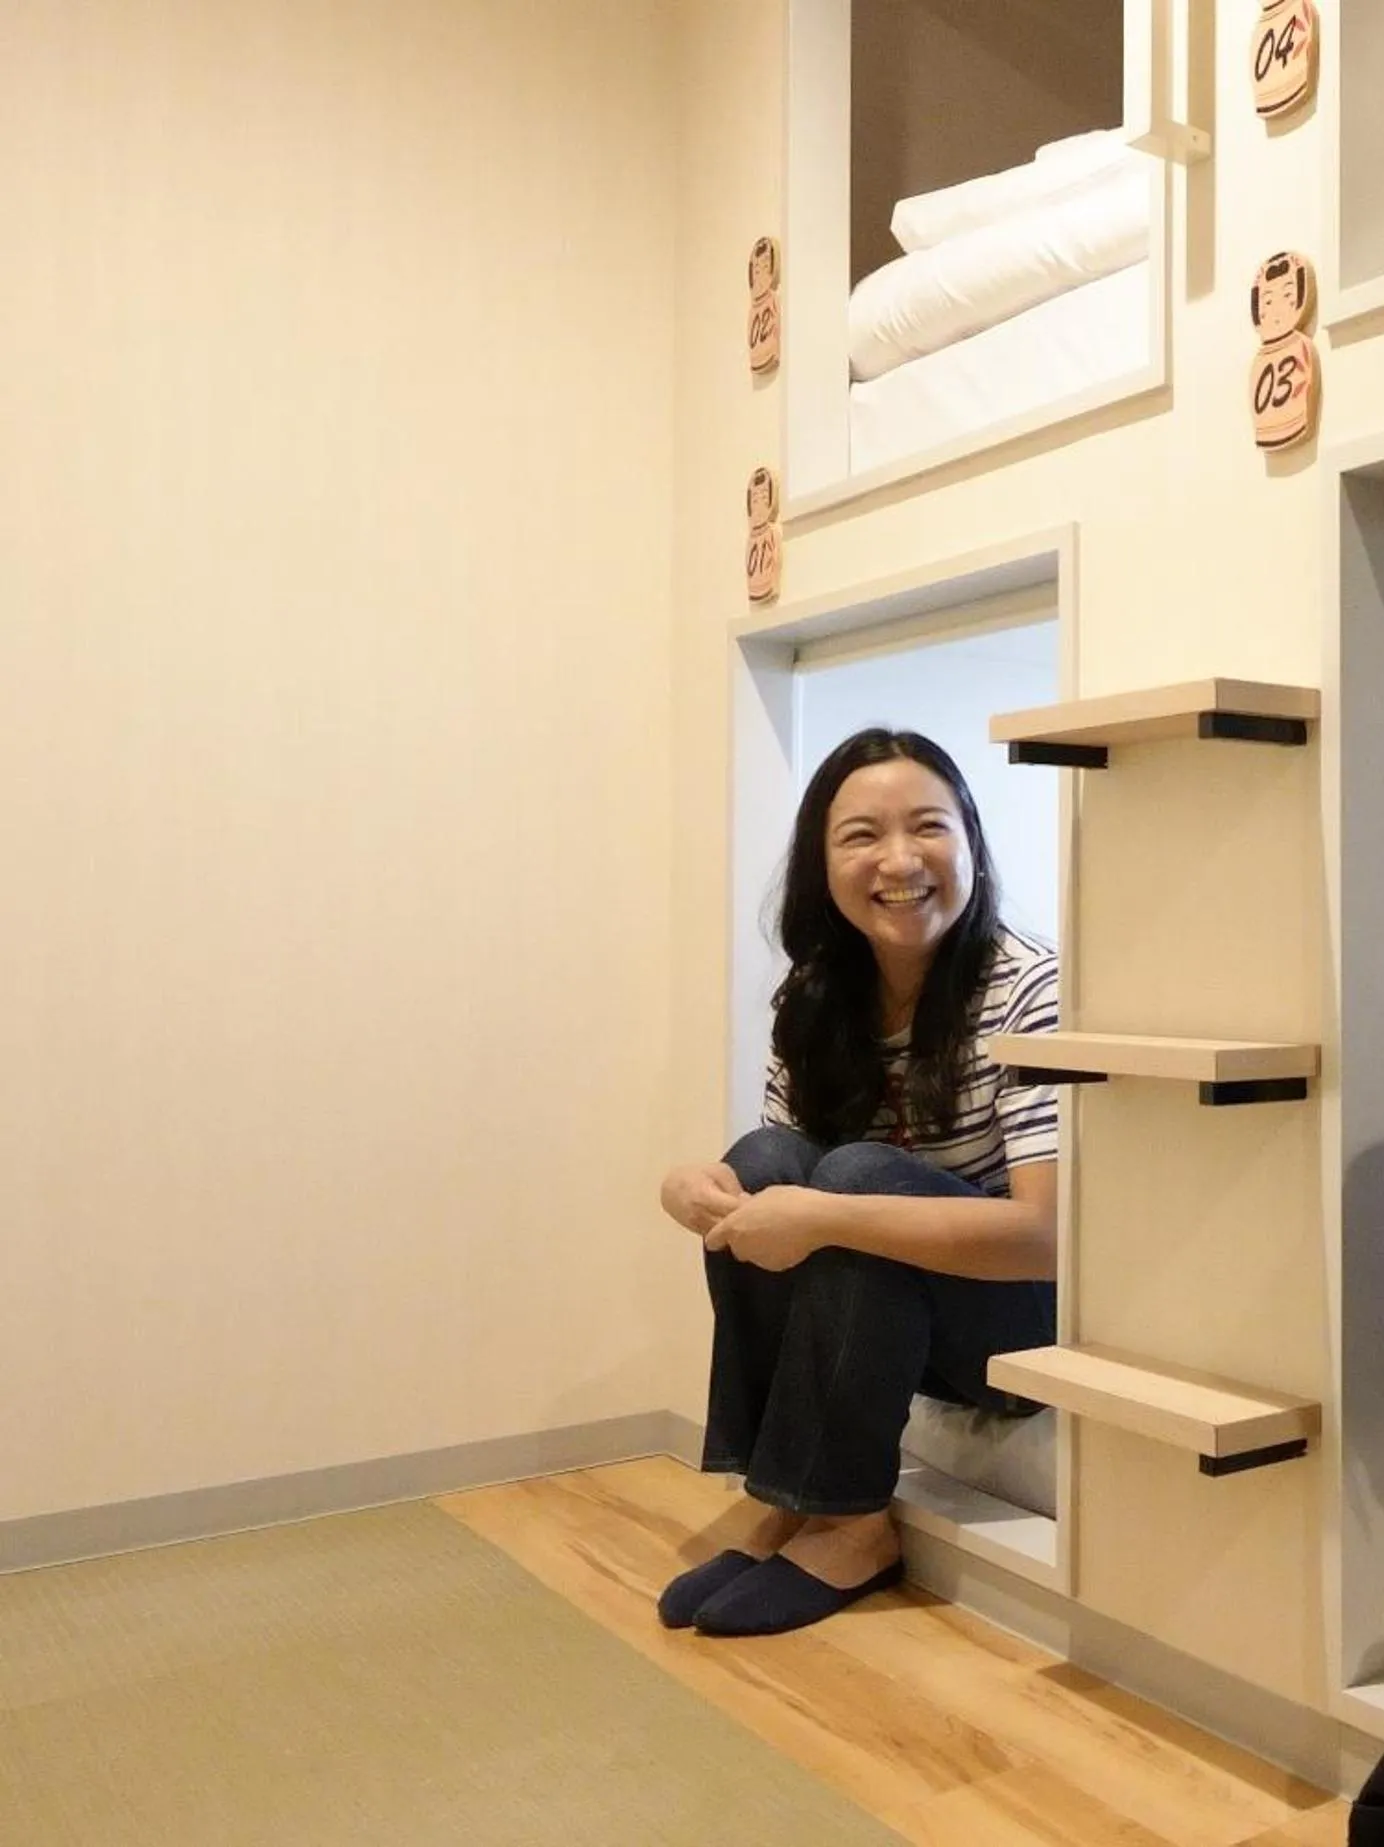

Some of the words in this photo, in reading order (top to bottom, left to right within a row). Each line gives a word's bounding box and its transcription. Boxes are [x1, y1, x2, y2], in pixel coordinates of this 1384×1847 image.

[1255, 15, 1294, 82] 04
[749, 307, 773, 349] 02
[1254, 354, 1297, 415] 03
[747, 540, 767, 577] 01
